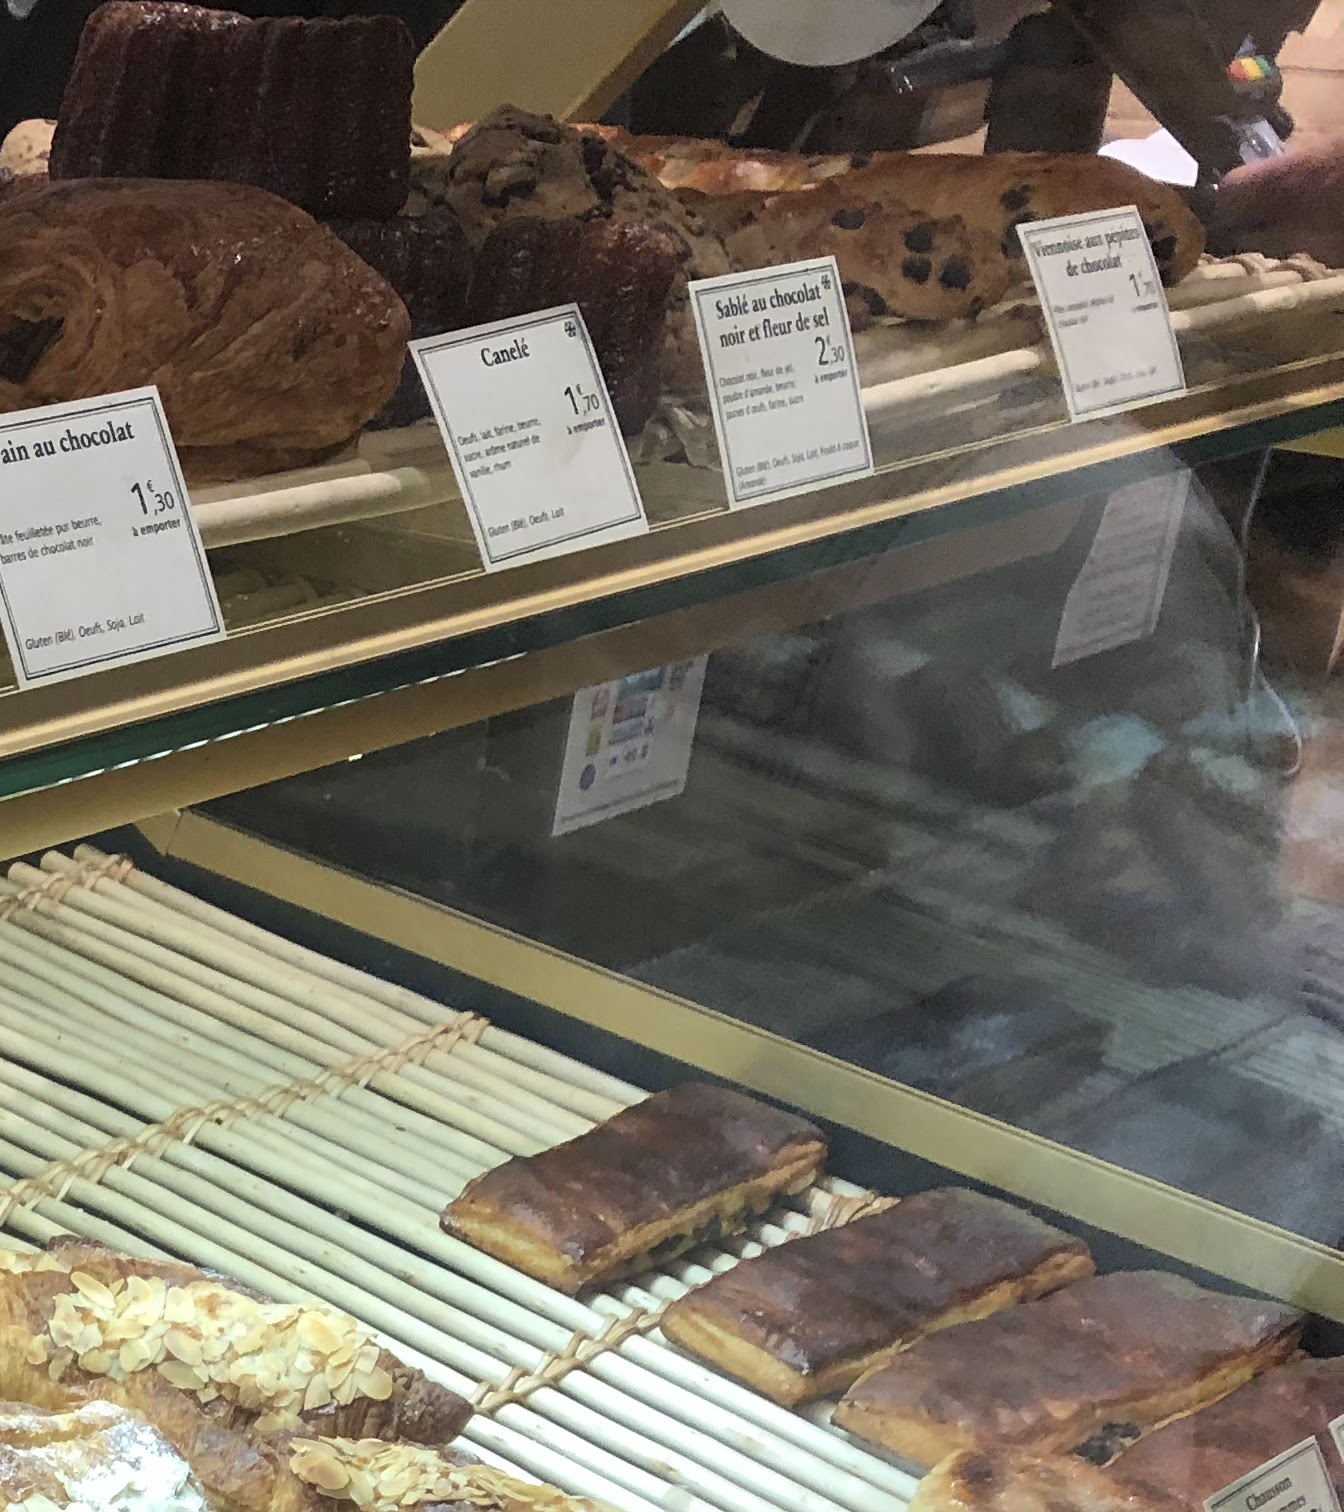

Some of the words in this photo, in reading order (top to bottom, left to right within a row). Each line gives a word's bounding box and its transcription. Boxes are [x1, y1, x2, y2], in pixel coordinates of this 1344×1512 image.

[1081, 252, 1123, 274] chocolat
[716, 294, 749, 320] Sablé
[752, 296, 767, 313] au
[769, 282, 822, 310] chocolat
[720, 325, 746, 348] noir
[749, 325, 761, 342] et
[763, 317, 793, 339] fleur
[796, 311, 811, 332] de
[813, 306, 830, 329] sel
[480, 337, 530, 367] Canelé
[34, 440, 56, 457] au
[59, 421, 135, 452] chocolat
[55, 523, 70, 536] pur
[132, 526, 139, 537] à
[140, 519, 181, 536] emporter
[0, 551, 27, 565] barres
[28, 547, 39, 559] de
[40, 540, 76, 556] chocolat
[77, 536, 95, 548] noir
[25, 635, 53, 650] Gluten
[128, 613, 145, 626] Lait
